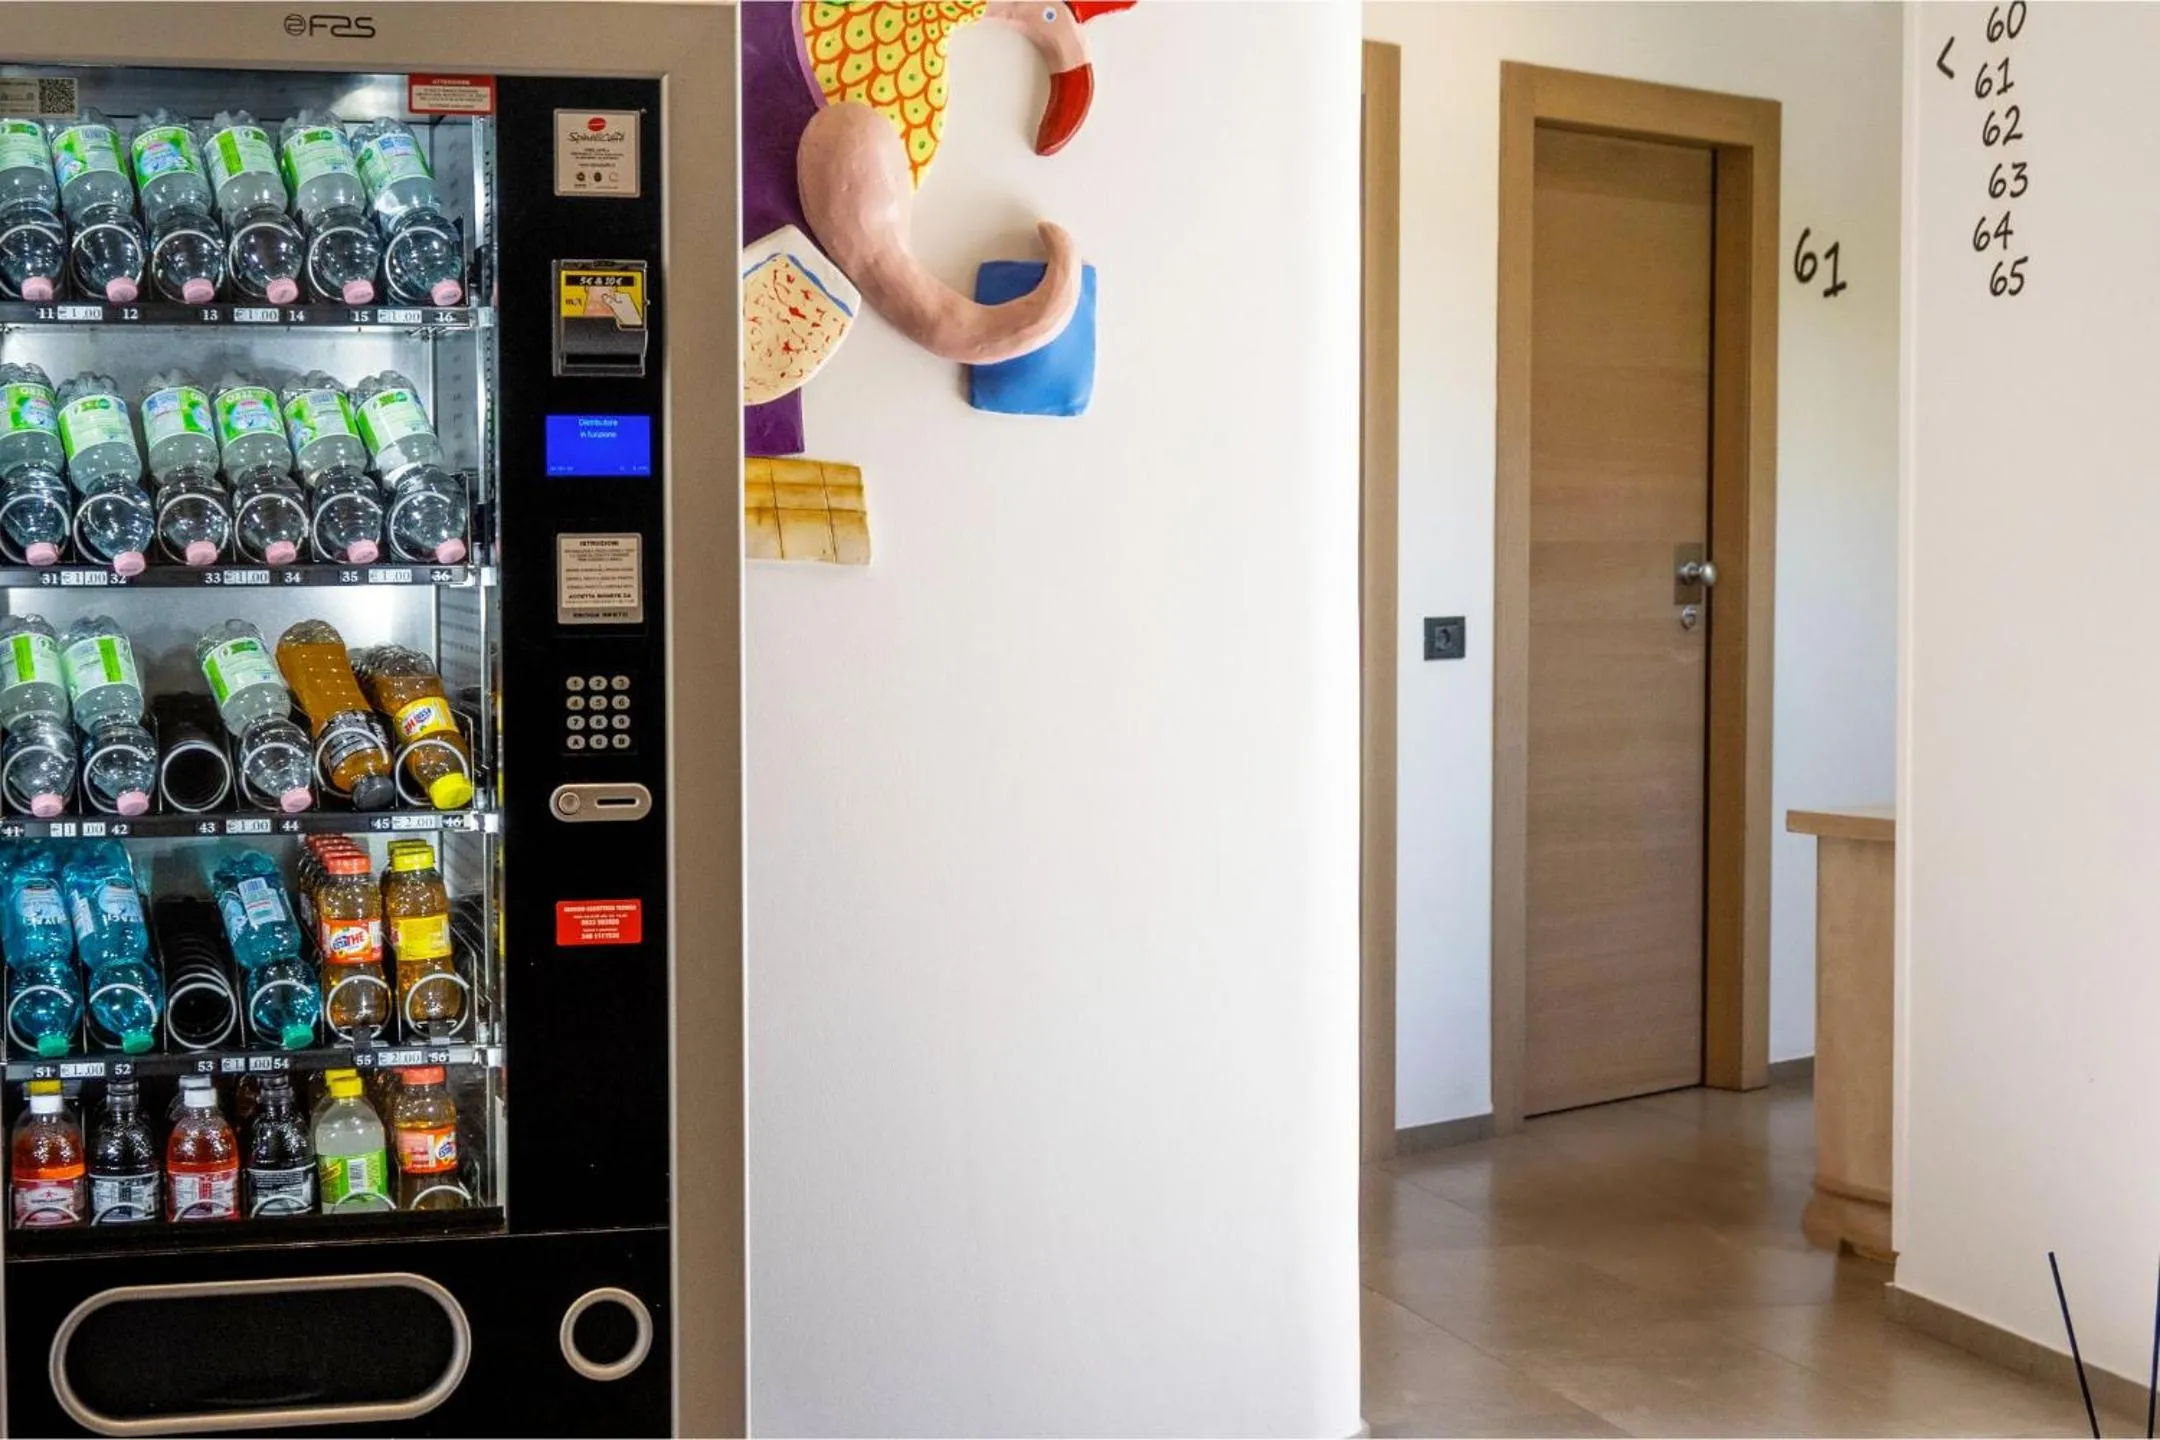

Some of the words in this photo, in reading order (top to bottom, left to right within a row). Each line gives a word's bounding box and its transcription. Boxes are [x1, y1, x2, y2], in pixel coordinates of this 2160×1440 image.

[1986, 1, 2027, 43] 60
[1975, 57, 2014, 99] 61
[1982, 105, 2023, 146] 62
[1988, 162, 2028, 198] 63
[1973, 211, 2013, 252] 64
[1794, 227, 1847, 298] 61
[1989, 256, 2028, 296] 65
[39, 308, 54, 320] 11
[123, 309, 138, 319] 12
[203, 310, 218, 320] 13
[289, 311, 305, 322] 14
[353, 311, 368, 322] 15
[42, 574, 57, 584] 31
[110, 574, 126, 584] 32
[205, 573, 221, 583] 33
[284, 573, 300, 583] 34
[342, 572, 357, 582] 35
[111, 824, 128, 835] 42
[200, 822, 216, 832] 43
[282, 821, 299, 831] 44
[374, 818, 389, 829] 45
[115, 1064, 131, 1074] 52
[198, 1061, 213, 1072] 53
[273, 1058, 289, 1069] 54
[356, 1054, 371, 1064] 55
